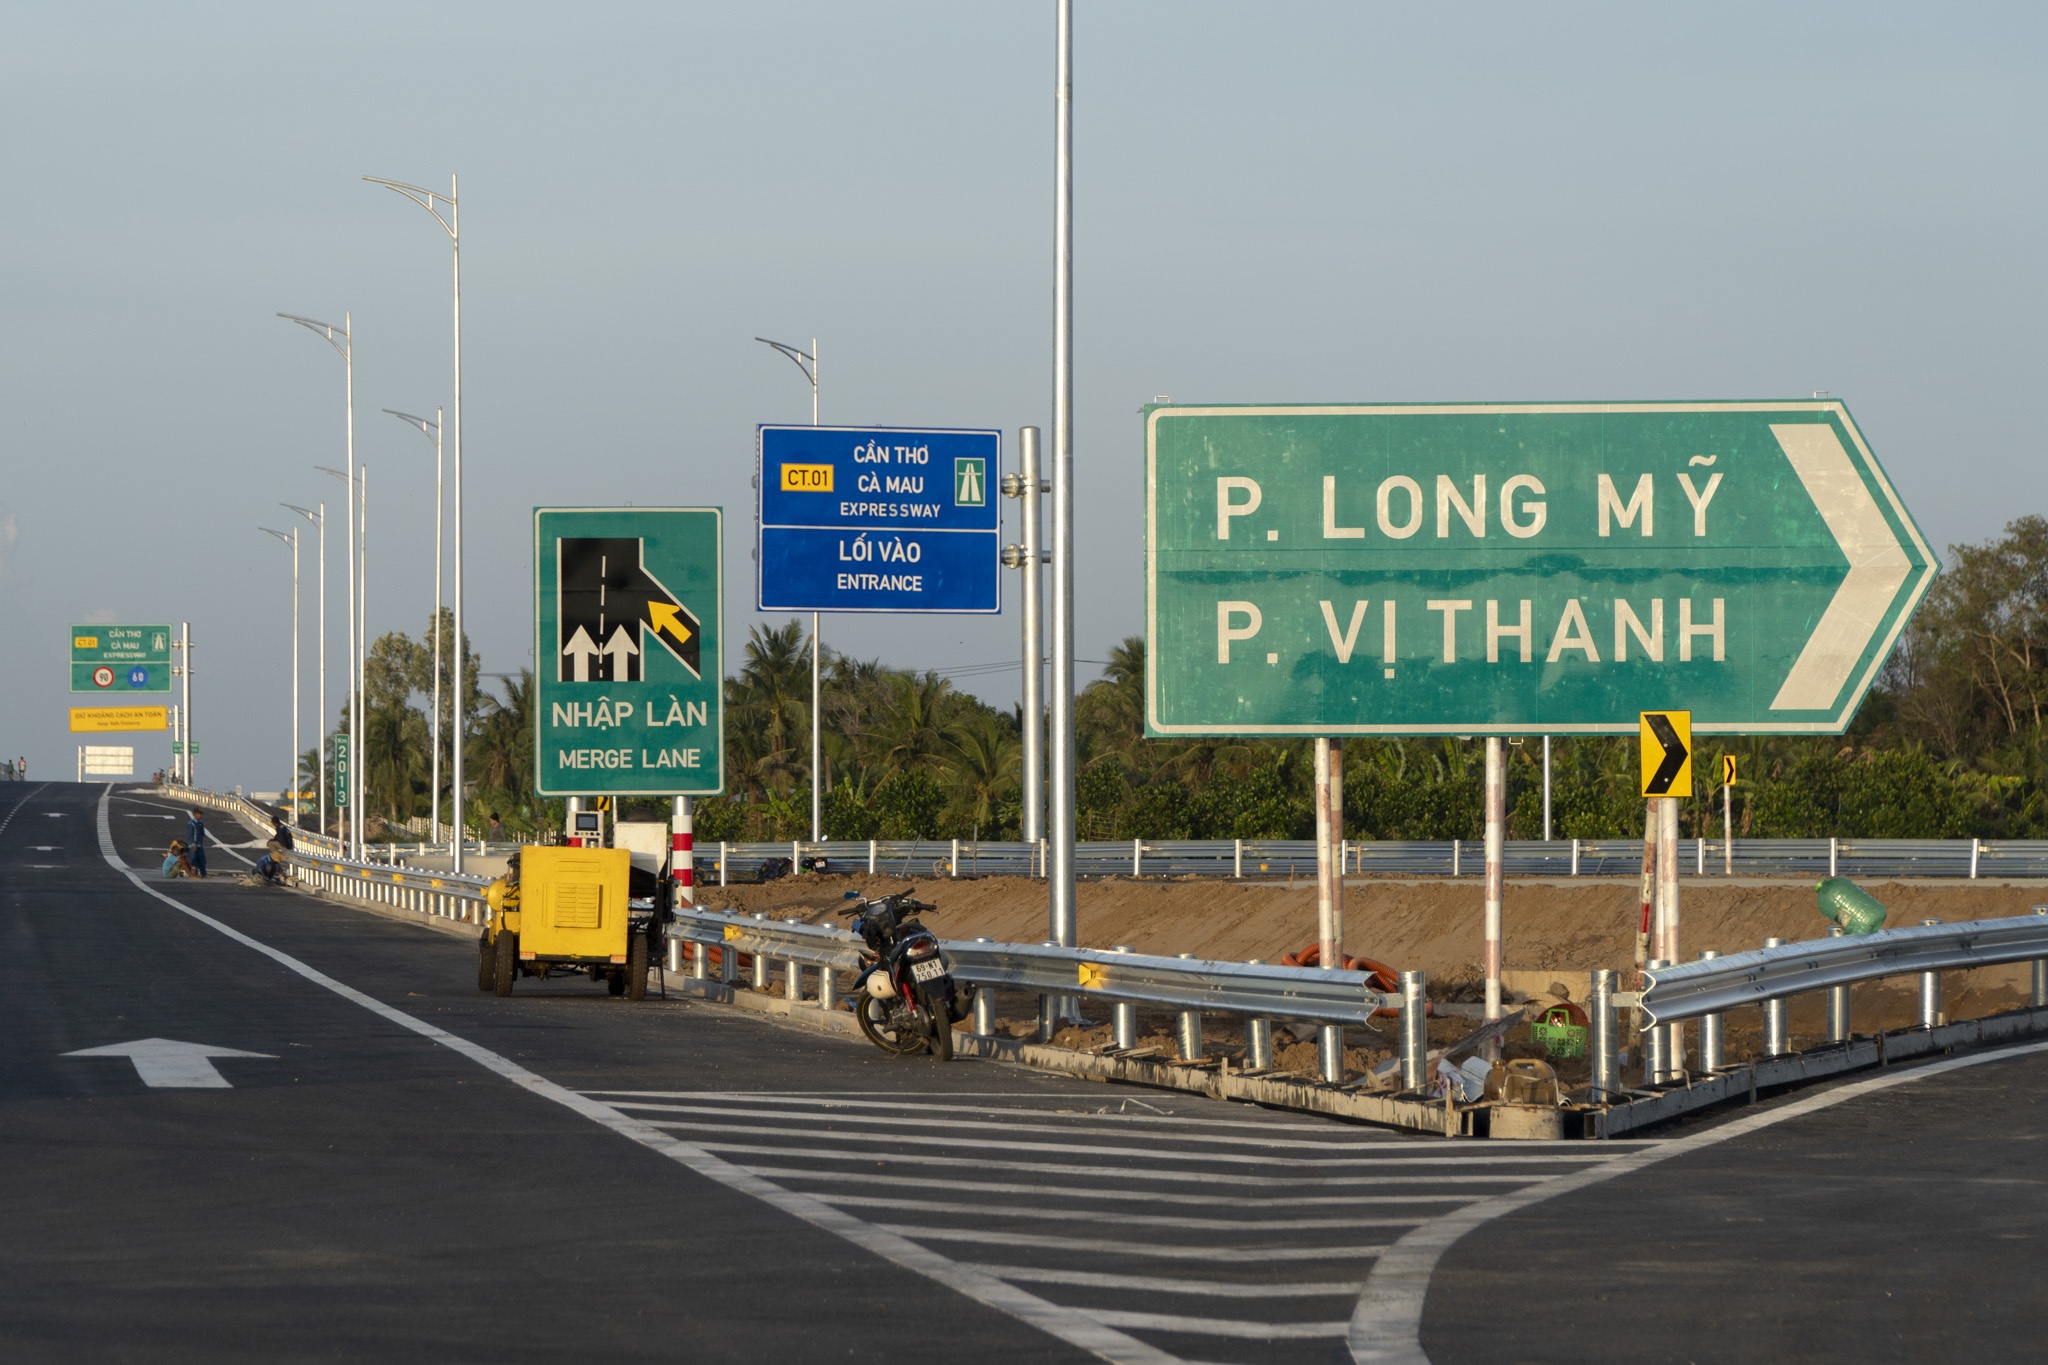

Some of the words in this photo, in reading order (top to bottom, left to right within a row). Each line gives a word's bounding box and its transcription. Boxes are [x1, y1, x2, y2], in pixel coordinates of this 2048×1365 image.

[853, 439, 890, 464] CẦN
[894, 444, 929, 465] THƠ
[788, 469, 828, 486] CT.01
[857, 471, 881, 493] CÀ
[886, 475, 924, 494] MAU
[1217, 476, 1279, 541] P.
[1323, 474, 1547, 539] LONG
[1597, 454, 1724, 537] MỸ
[840, 501, 941, 518] EXPRESSWAY
[839, 532, 873, 562] LỐI
[878, 536, 921, 563] VÀO
[837, 573, 923, 592] ENTRANCE
[1217, 601, 1279, 664] P.
[1319, 600, 1396, 679] VỊ
[1427, 598, 1725, 664] THANH
[99, 673, 109, 682] 90
[132, 672, 144, 682] 60
[552, 695, 634, 731] NHẬP
[647, 694, 707, 727] LÀN
[559, 749, 633, 769] MERGE
[642, 748, 701, 768] LANE
